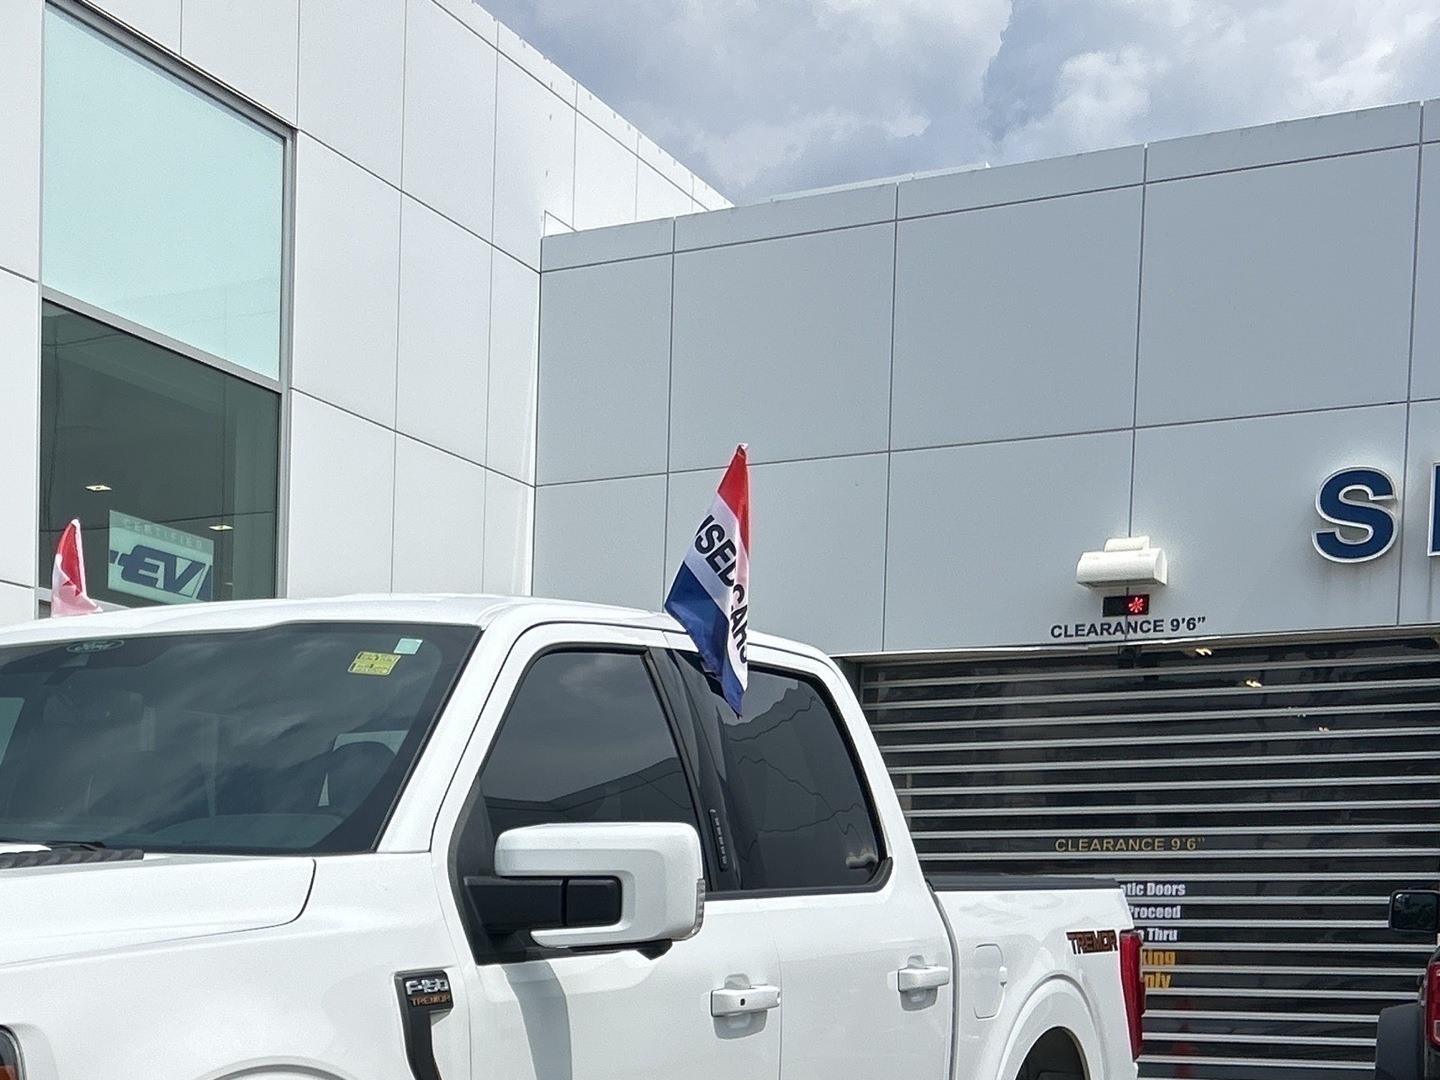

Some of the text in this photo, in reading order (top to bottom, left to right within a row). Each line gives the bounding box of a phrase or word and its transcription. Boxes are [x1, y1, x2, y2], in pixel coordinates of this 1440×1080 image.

[1312, 462, 1440, 564] S
[1050, 619, 1164, 639] CLEARANCE
[1055, 838, 1165, 852] CLEARANCE
[1147, 882, 1186, 896] Doors
[1066, 930, 1119, 955] TREMOR
[1147, 928, 1178, 942] Thru
[405, 979, 449, 995] F-150
